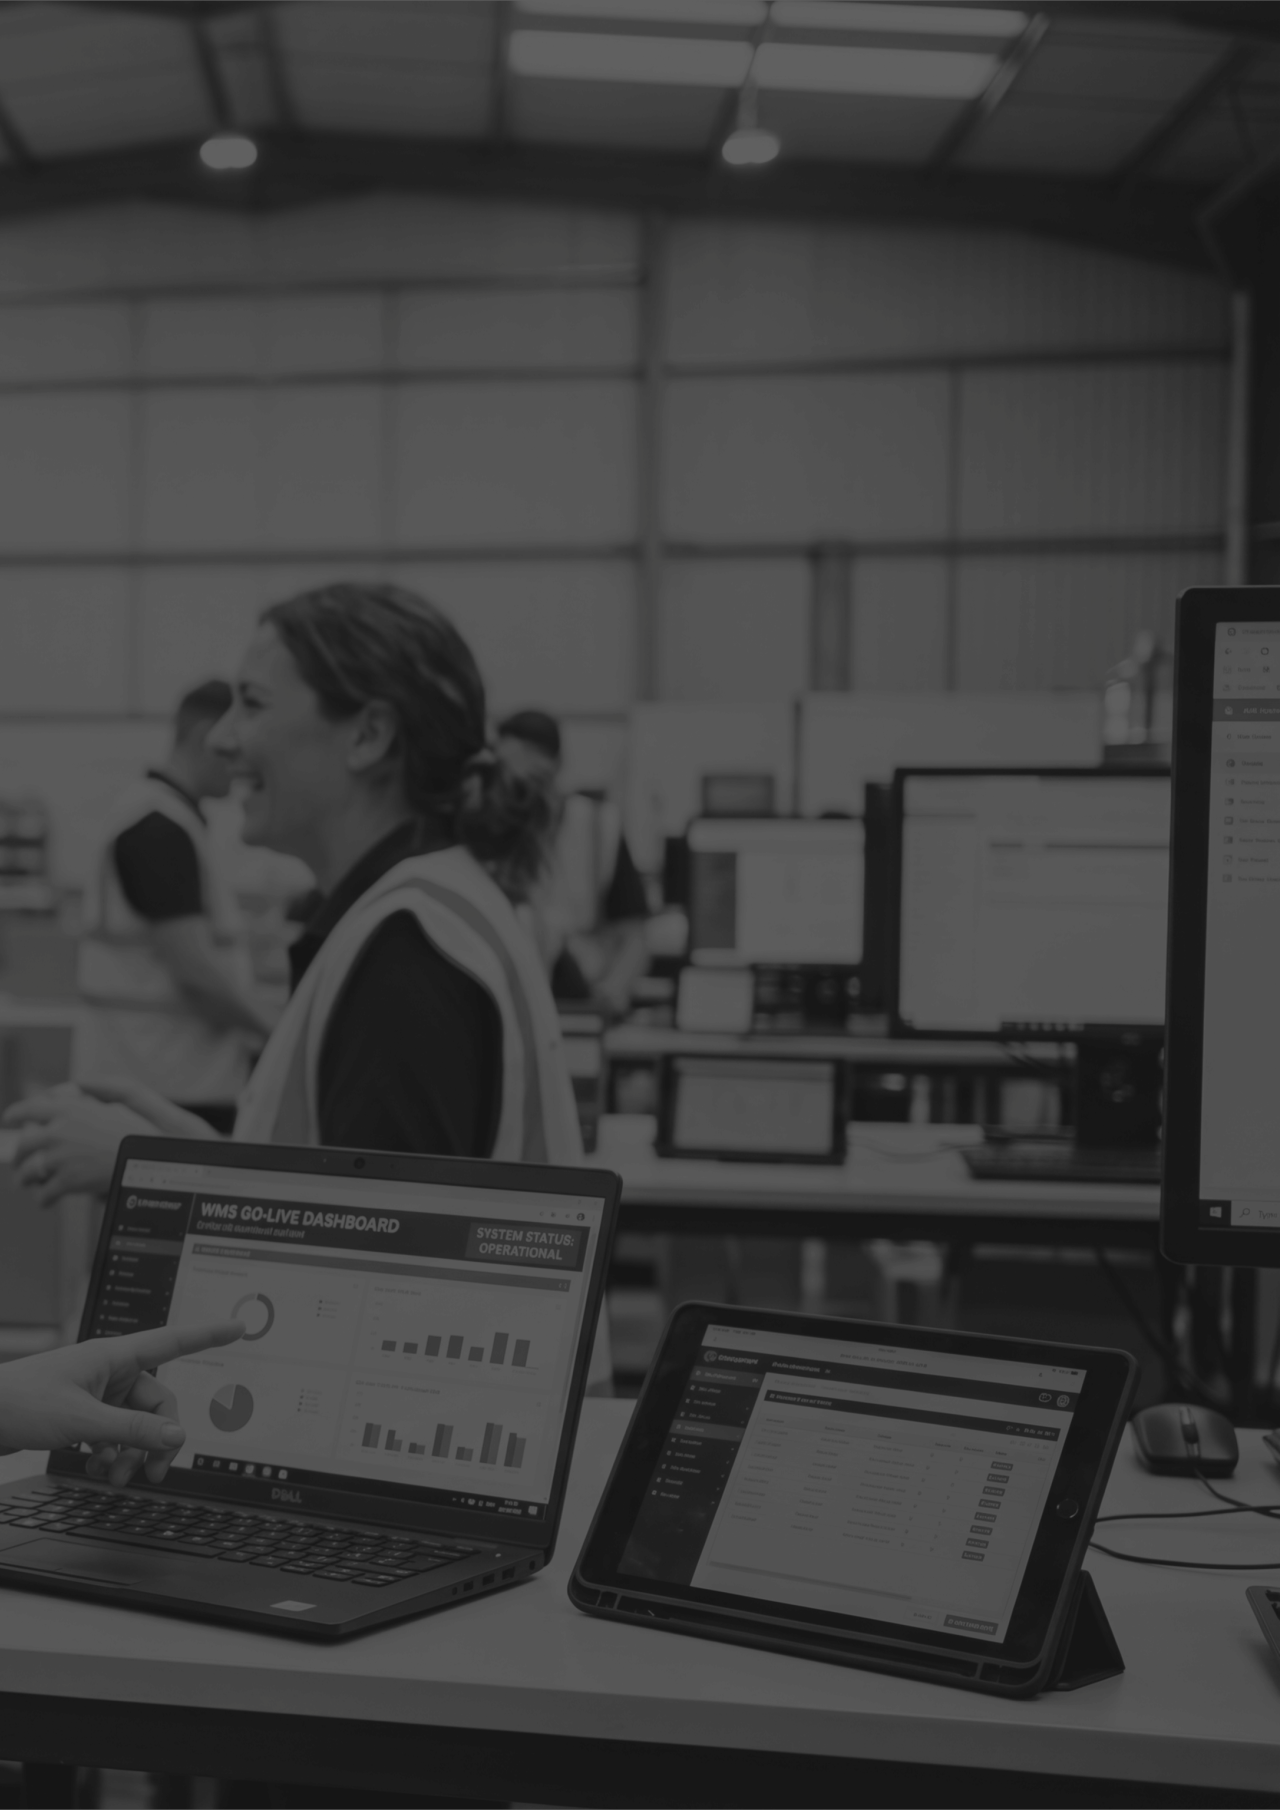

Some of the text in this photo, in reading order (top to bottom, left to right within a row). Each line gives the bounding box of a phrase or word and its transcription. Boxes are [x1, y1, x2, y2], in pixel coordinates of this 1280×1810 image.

[201, 1202, 238, 1220] WMS
[302, 1211, 401, 1234] DASHBOARD
[476, 1227, 575, 1247] SYSTEM STATUS:
[479, 1242, 563, 1261] OPERATIONAL
